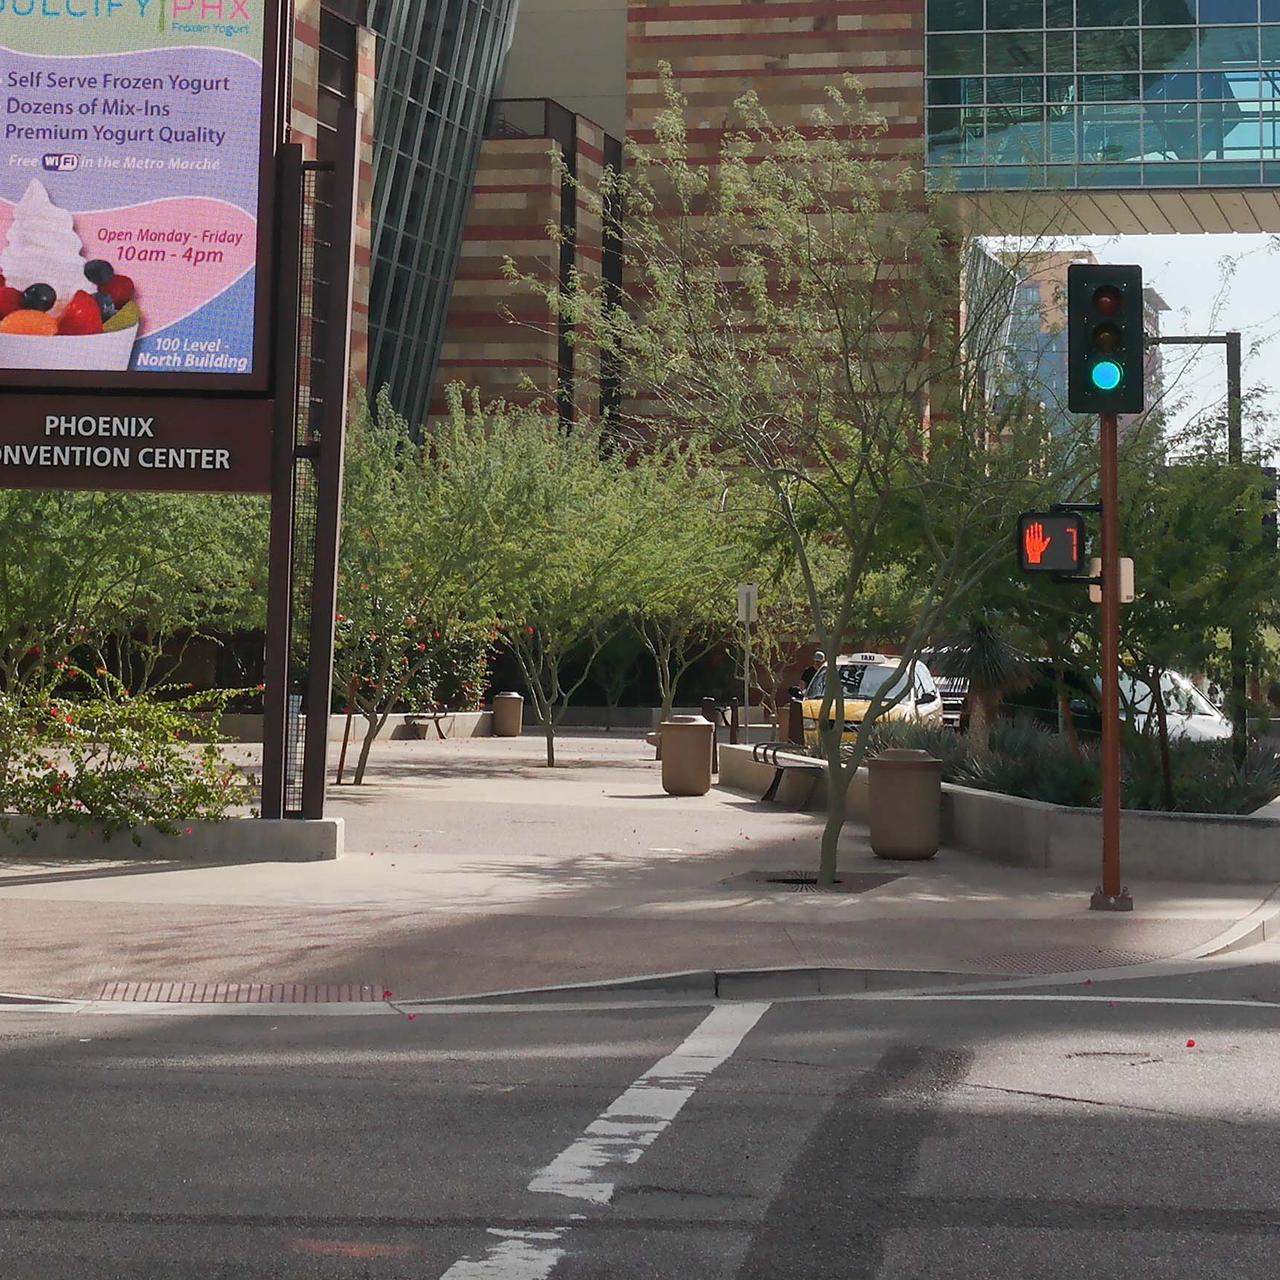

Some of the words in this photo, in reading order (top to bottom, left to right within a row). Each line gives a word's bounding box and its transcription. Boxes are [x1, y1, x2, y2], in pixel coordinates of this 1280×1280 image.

[172, 22, 209, 33] Frozen
[212, 23, 251, 37] Yogurt
[8, 71, 41, 88] Self
[47, 72, 97, 89] Serve
[103, 73, 163, 90] Frozen
[169, 75, 230, 94] Yogurt
[6, 97, 73, 115] Dozens
[79, 98, 98, 115] of
[102, 99, 170, 117] Mix-Ins
[5, 124, 88, 141] Premium
[93, 125, 154, 145] Yogurt
[159, 127, 226, 146] Quality
[9, 154, 39, 168] Free
[81, 156, 94, 168] in
[97, 156, 118, 169] the
[121, 157, 164, 170] Metro
[97, 228, 132, 244] Open
[137, 229, 191, 245] Monday
[201, 230, 243, 246] Friday
[116, 246, 166, 261] 10am
[182, 247, 224, 266] 4pm
[155, 338, 180, 352] 100
[183, 338, 221, 352] Level
[137, 353, 178, 367] North
[185, 353, 248, 371] Building
[44, 416, 154, 437] PHOENIX
[138, 447, 230, 469] CENTER
